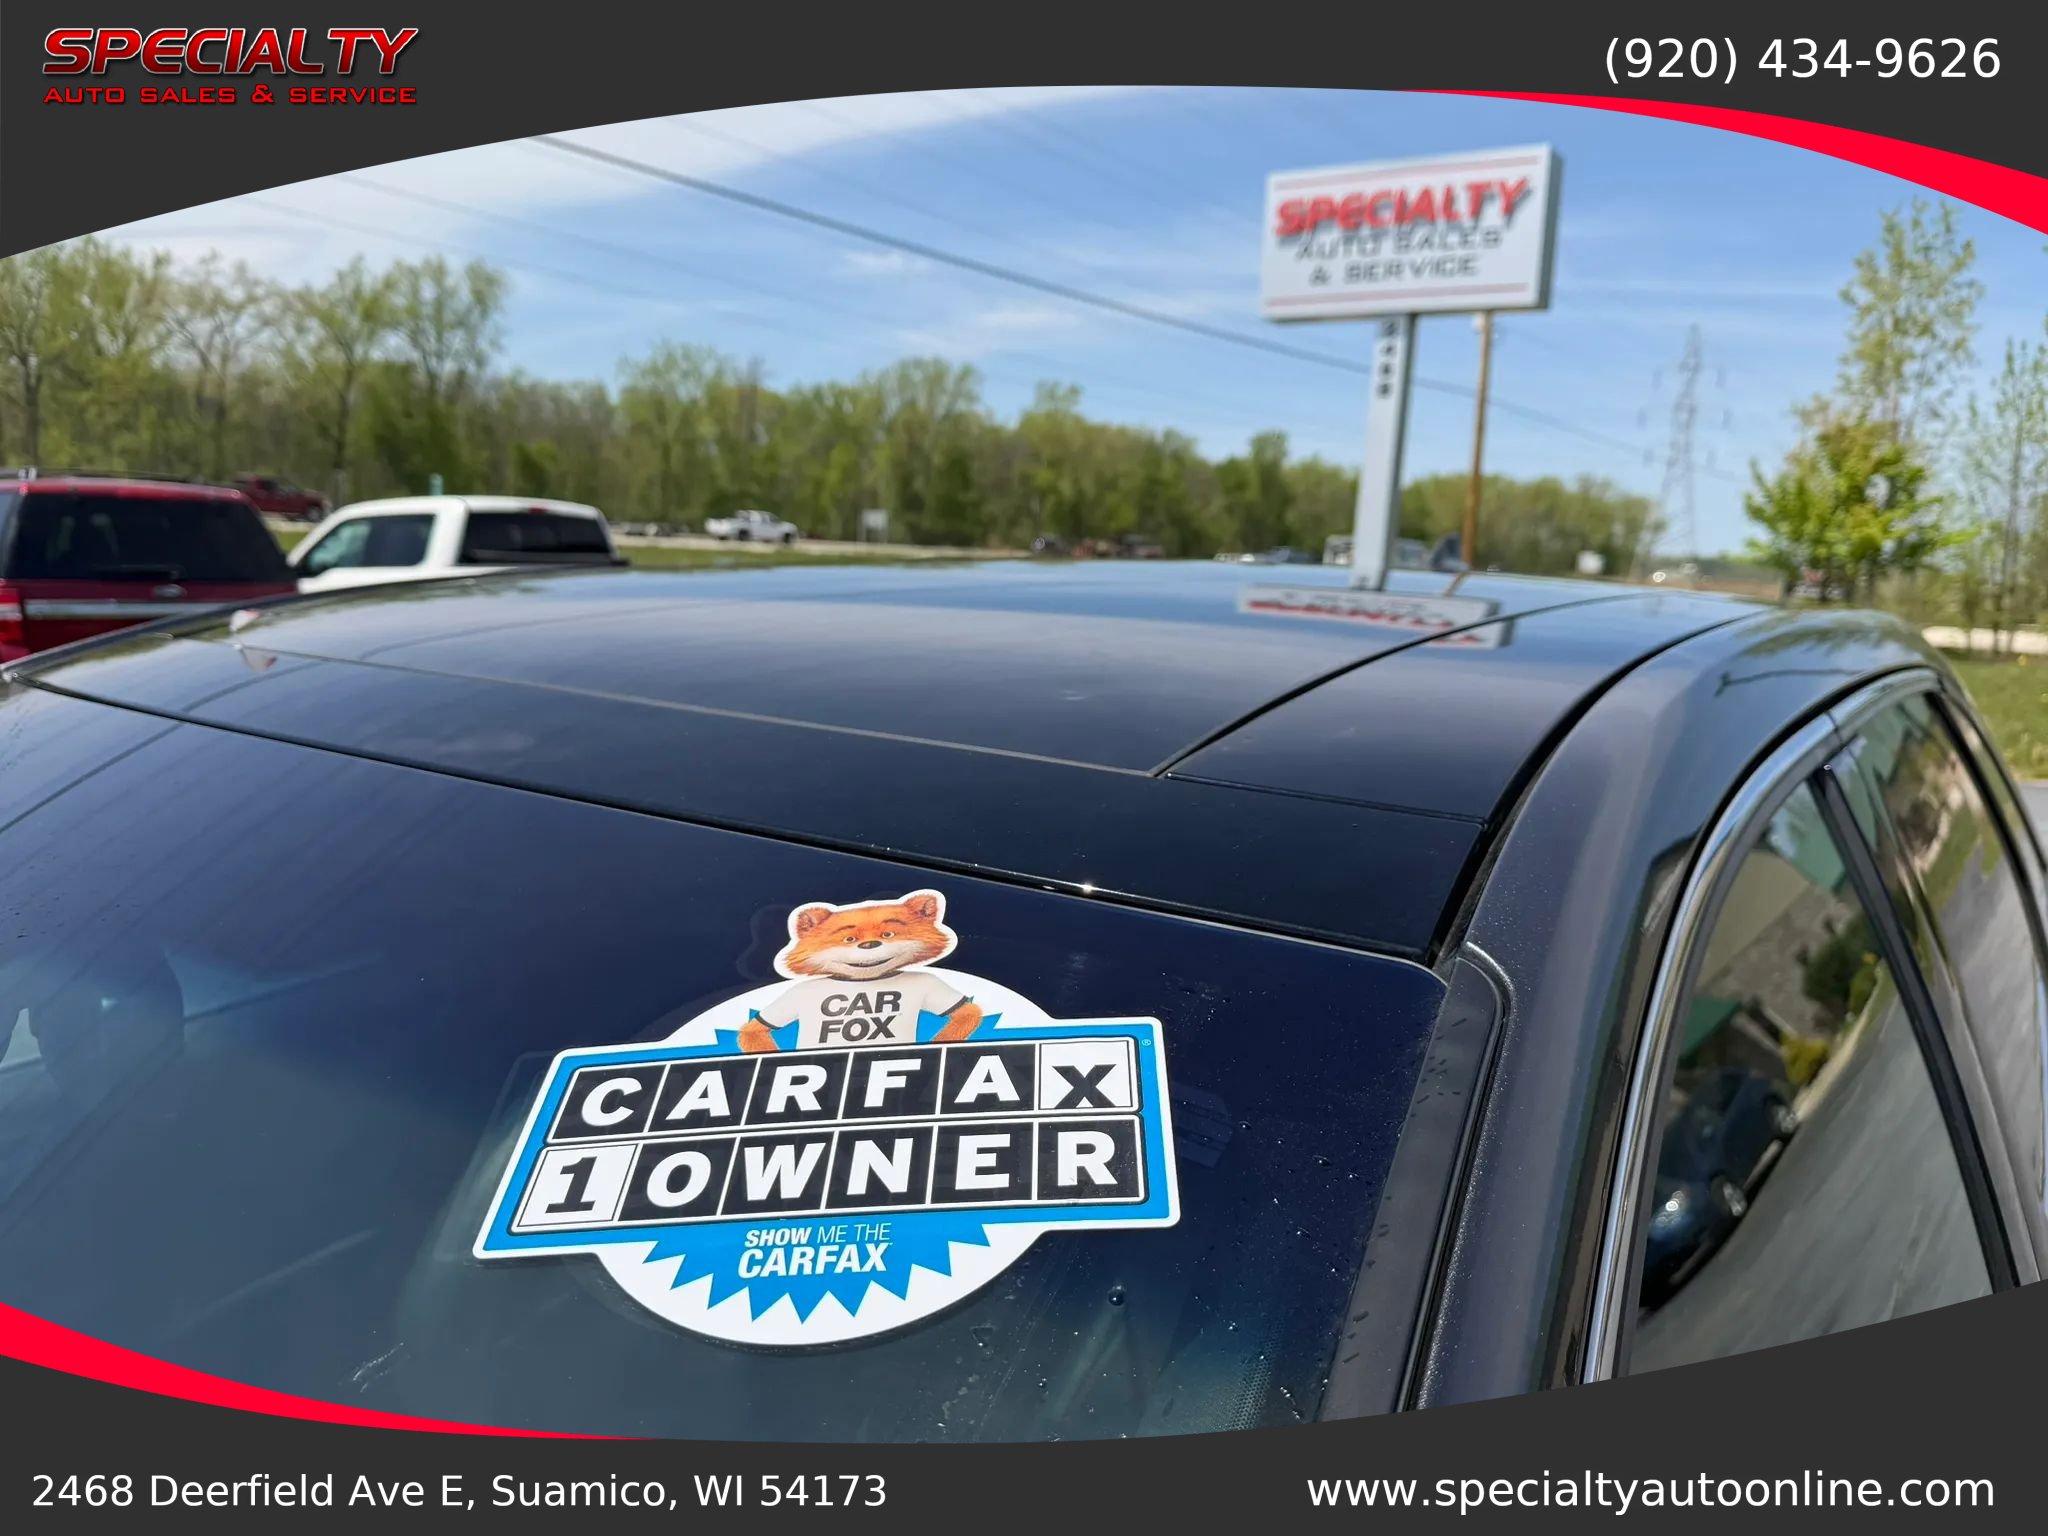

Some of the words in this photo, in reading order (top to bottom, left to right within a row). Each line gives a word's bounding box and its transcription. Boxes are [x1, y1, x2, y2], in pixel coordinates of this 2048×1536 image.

[1276, 178, 1532, 240] SPECIALTY
[1297, 231, 1385, 262] AUTO
[1392, 224, 1503, 255] SALES
[1343, 254, 1480, 283] SERVICE
[821, 991, 901, 1017] CAR
[819, 1015, 896, 1043] FOX
[581, 1055, 1117, 1126] CARFAX
[646, 1130, 1116, 1208] OWNER
[745, 1227, 812, 1248] SHOW
[817, 1225, 848, 1243] ME
[854, 1223, 892, 1241] THE
[738, 1243, 889, 1279] CARFAX
